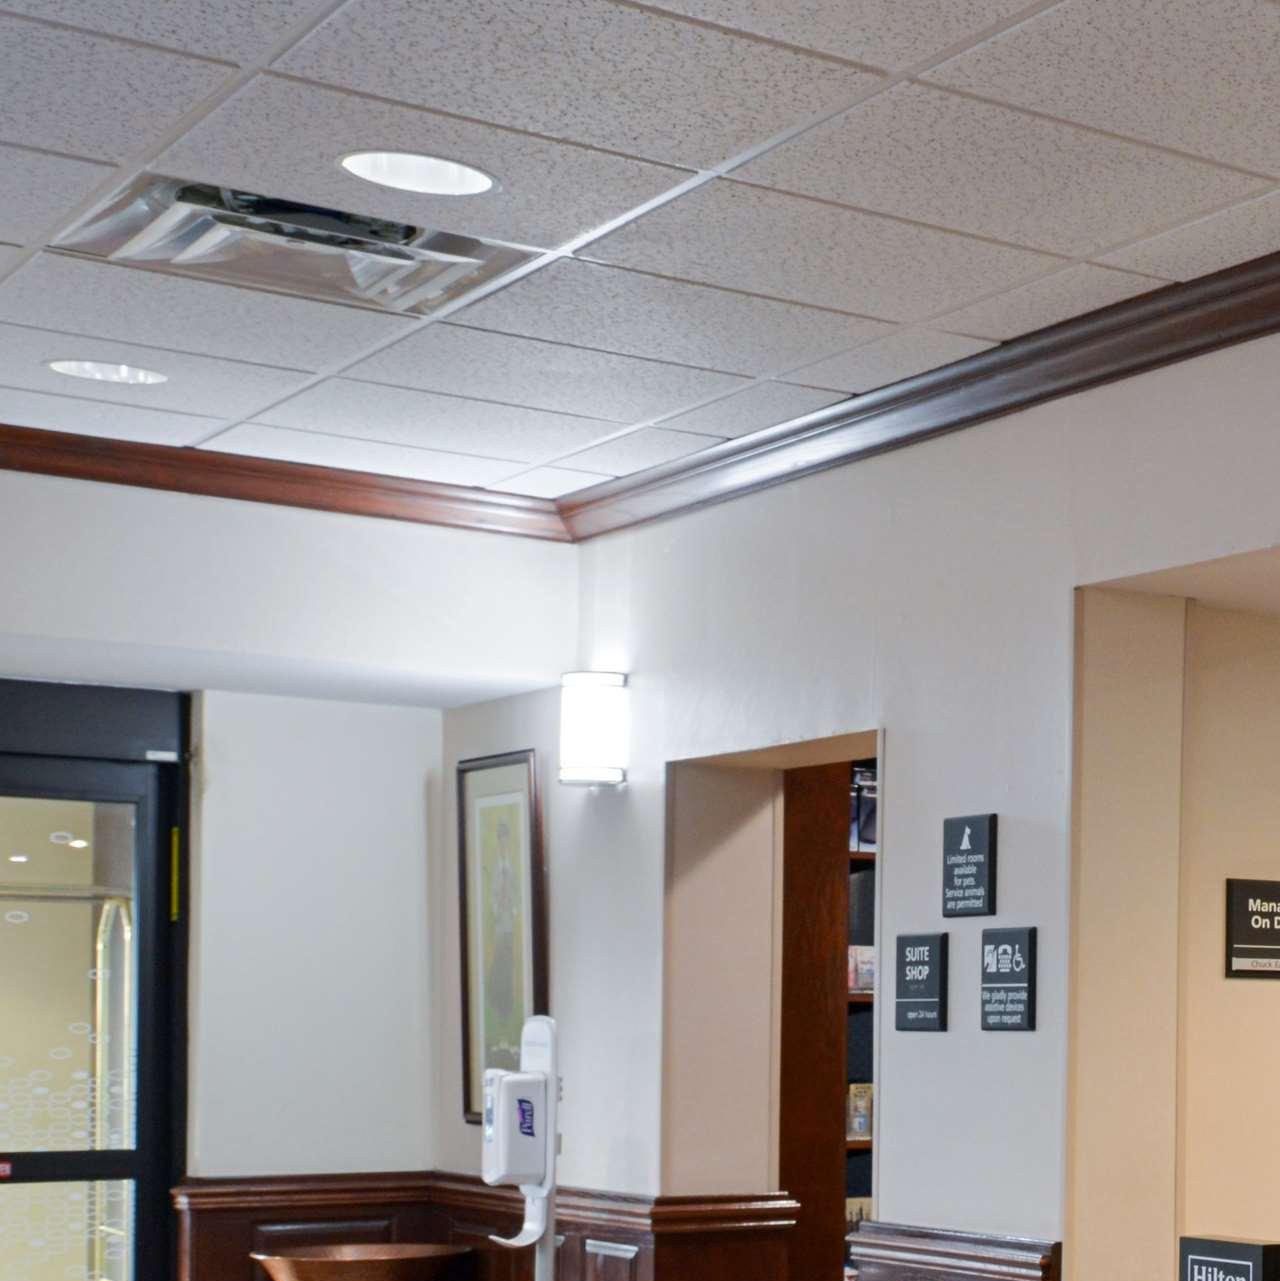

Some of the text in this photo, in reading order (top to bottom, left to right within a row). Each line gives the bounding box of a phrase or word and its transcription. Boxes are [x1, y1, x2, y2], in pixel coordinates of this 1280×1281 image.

[1251, 915, 1270, 929] On
[905, 946, 930, 961] SUITE
[905, 965, 930, 980] SHOP
